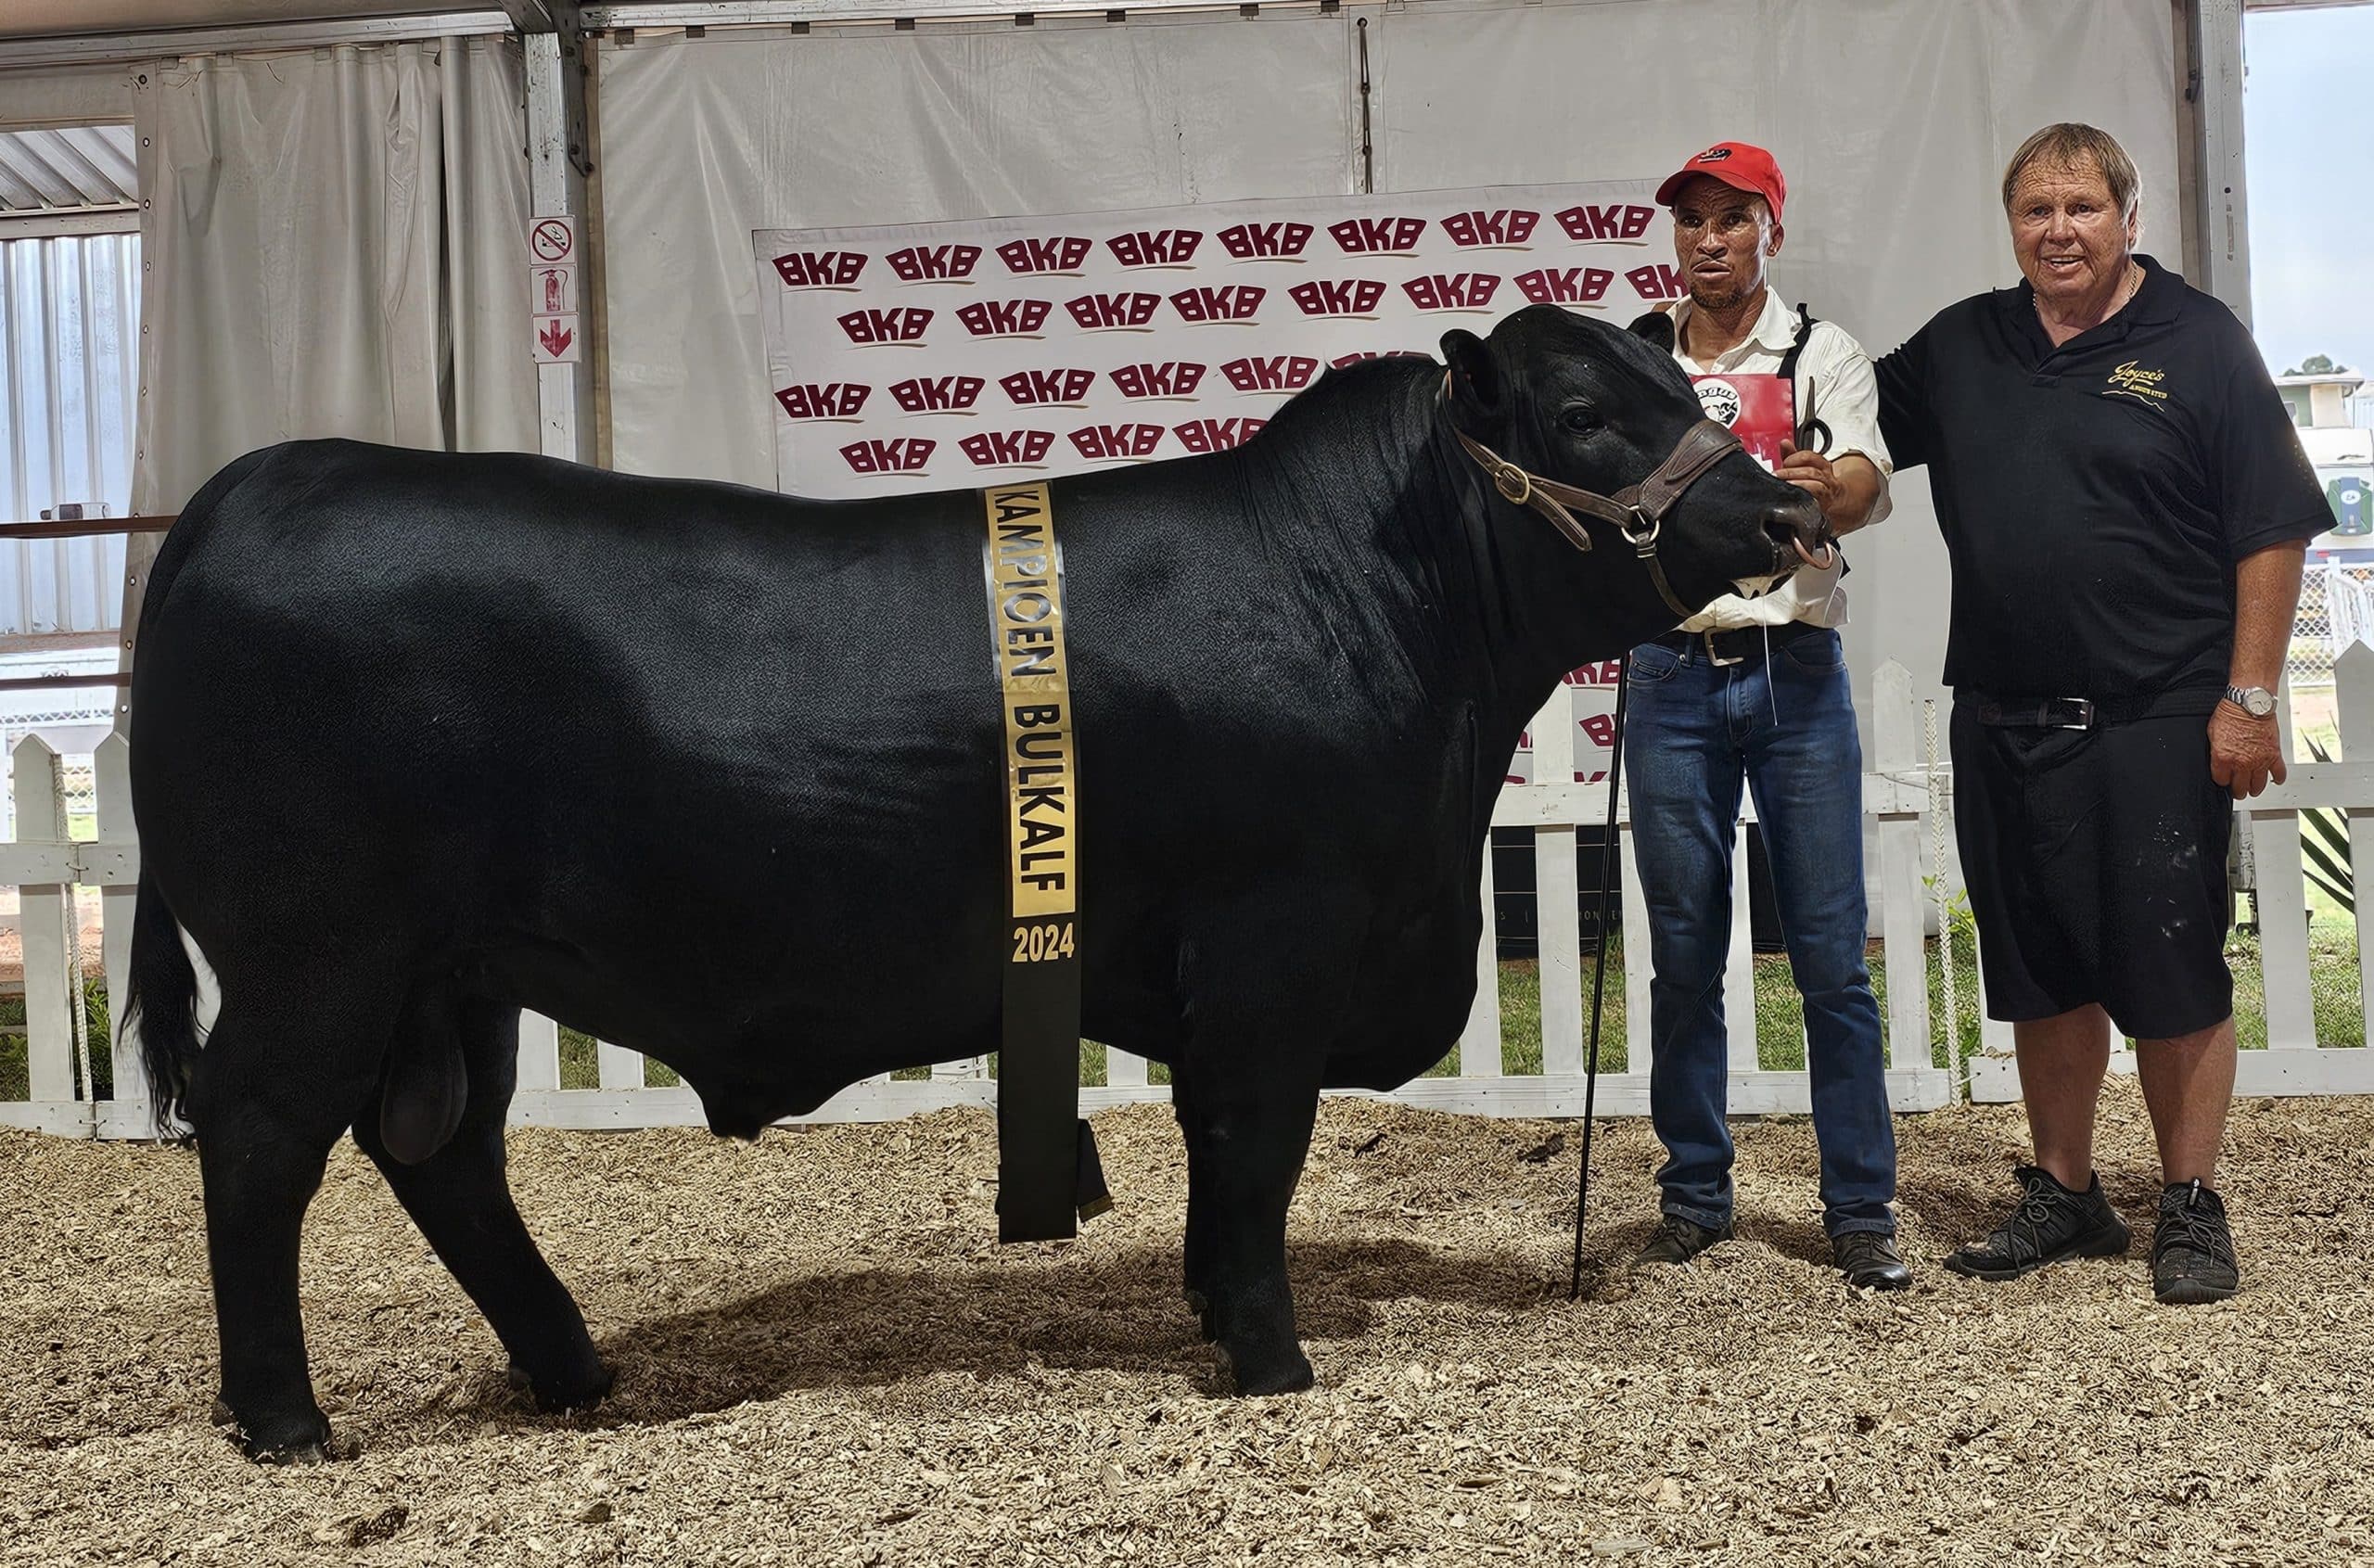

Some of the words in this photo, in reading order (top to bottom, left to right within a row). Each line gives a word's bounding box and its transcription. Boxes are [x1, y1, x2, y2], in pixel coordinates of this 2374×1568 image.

[773, 252, 868, 286] BKB
[887, 246, 982, 281] BKB
[996, 237, 1094, 273] BKB
[1106, 230, 1205, 266] BKB
[1216, 223, 1315, 258] BKB
[1328, 219, 1428, 253] BKB
[1439, 210, 1542, 247] BKB
[1554, 204, 1657, 240] BKB
[838, 309, 935, 343] BKB
[955, 300, 1053, 336] BKB
[1062, 293, 1164, 328] BKB
[1169, 286, 1269, 322] BKB
[1288, 281, 1388, 315] BKB
[1400, 274, 1502, 310] BKB
[1512, 267, 1616, 304] BKB
[1624, 264, 1691, 300] BK
[776, 384, 872, 418] BKB
[888, 376, 986, 411] BKB
[998, 370, 1097, 404] BKB
[1110, 363, 1208, 398] BKB
[1219, 356, 1320, 391] BKB
[2108, 359, 2165, 388] Joyce's
[839, 439, 938, 473] BKB
[957, 430, 1056, 465] BKB
[1066, 423, 1167, 459] BKB
[993, 490, 1057, 677] KAMPIOEN
[1013, 703, 1066, 892] BULKALF
[1012, 922, 1075, 962] 2024
